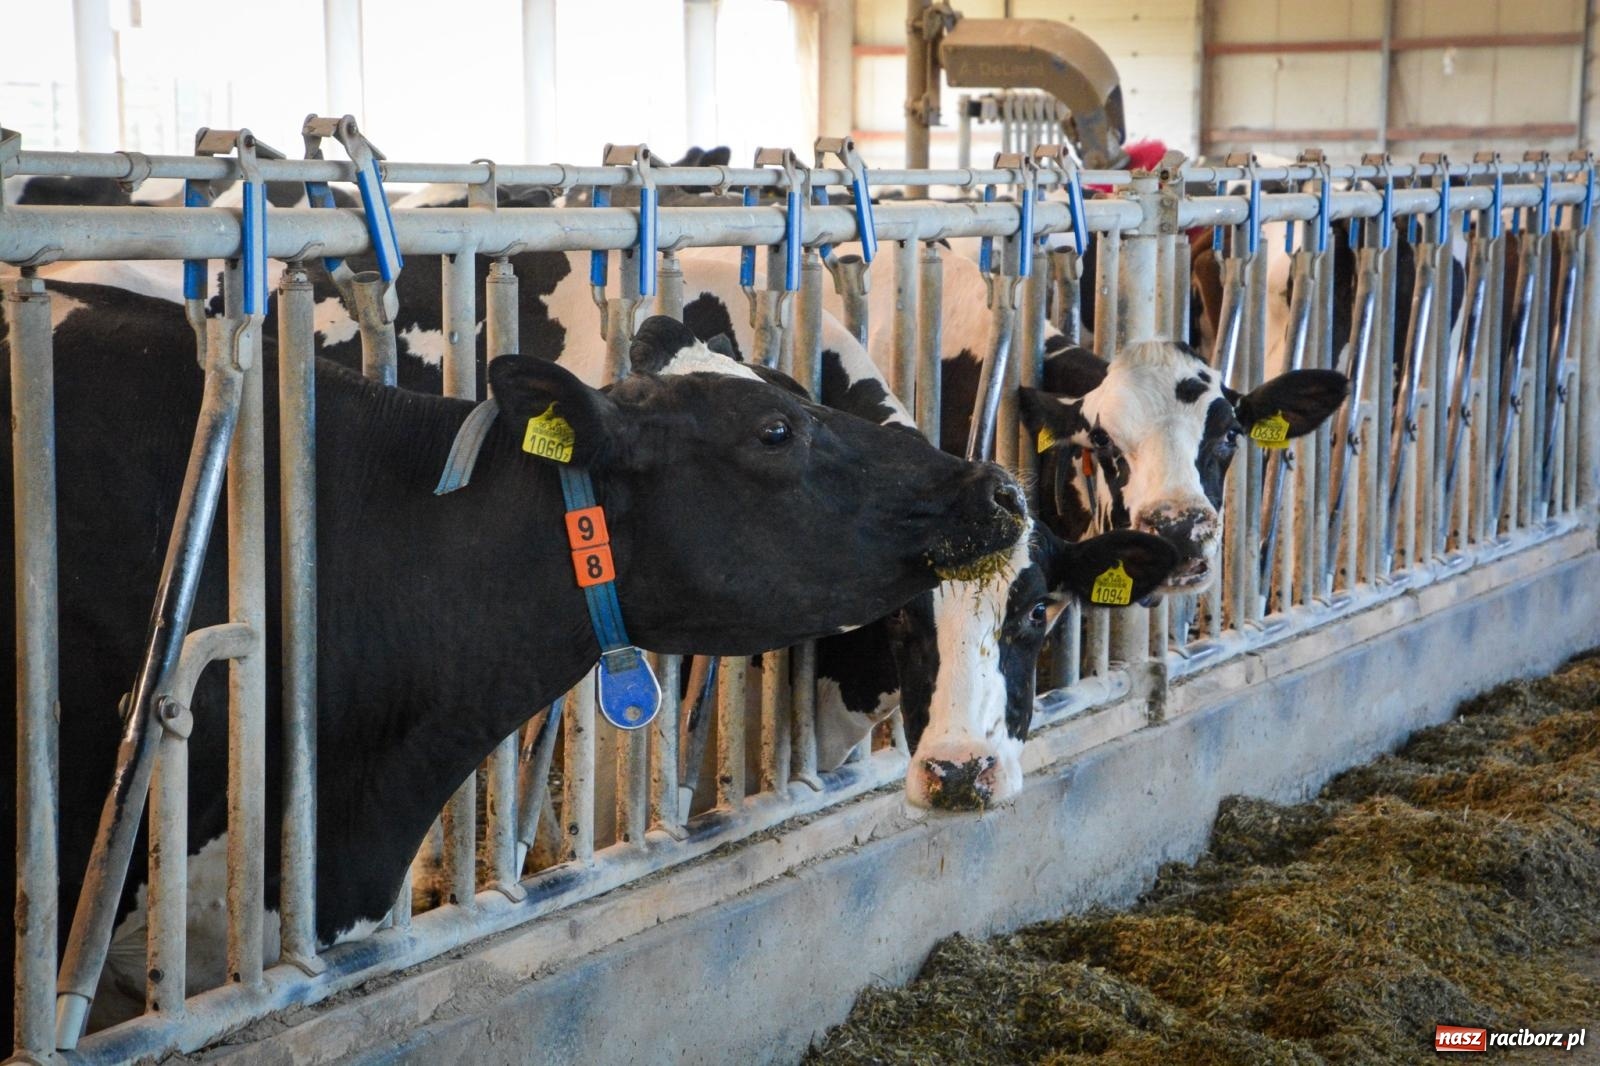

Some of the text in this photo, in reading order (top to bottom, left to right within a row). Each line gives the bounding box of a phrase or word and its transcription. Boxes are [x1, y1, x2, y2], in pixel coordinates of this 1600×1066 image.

[530, 434, 565, 459] 1060
[577, 515, 595, 541] 9
[586, 554, 603, 579] 8
[1095, 587, 1123, 603] 1094
